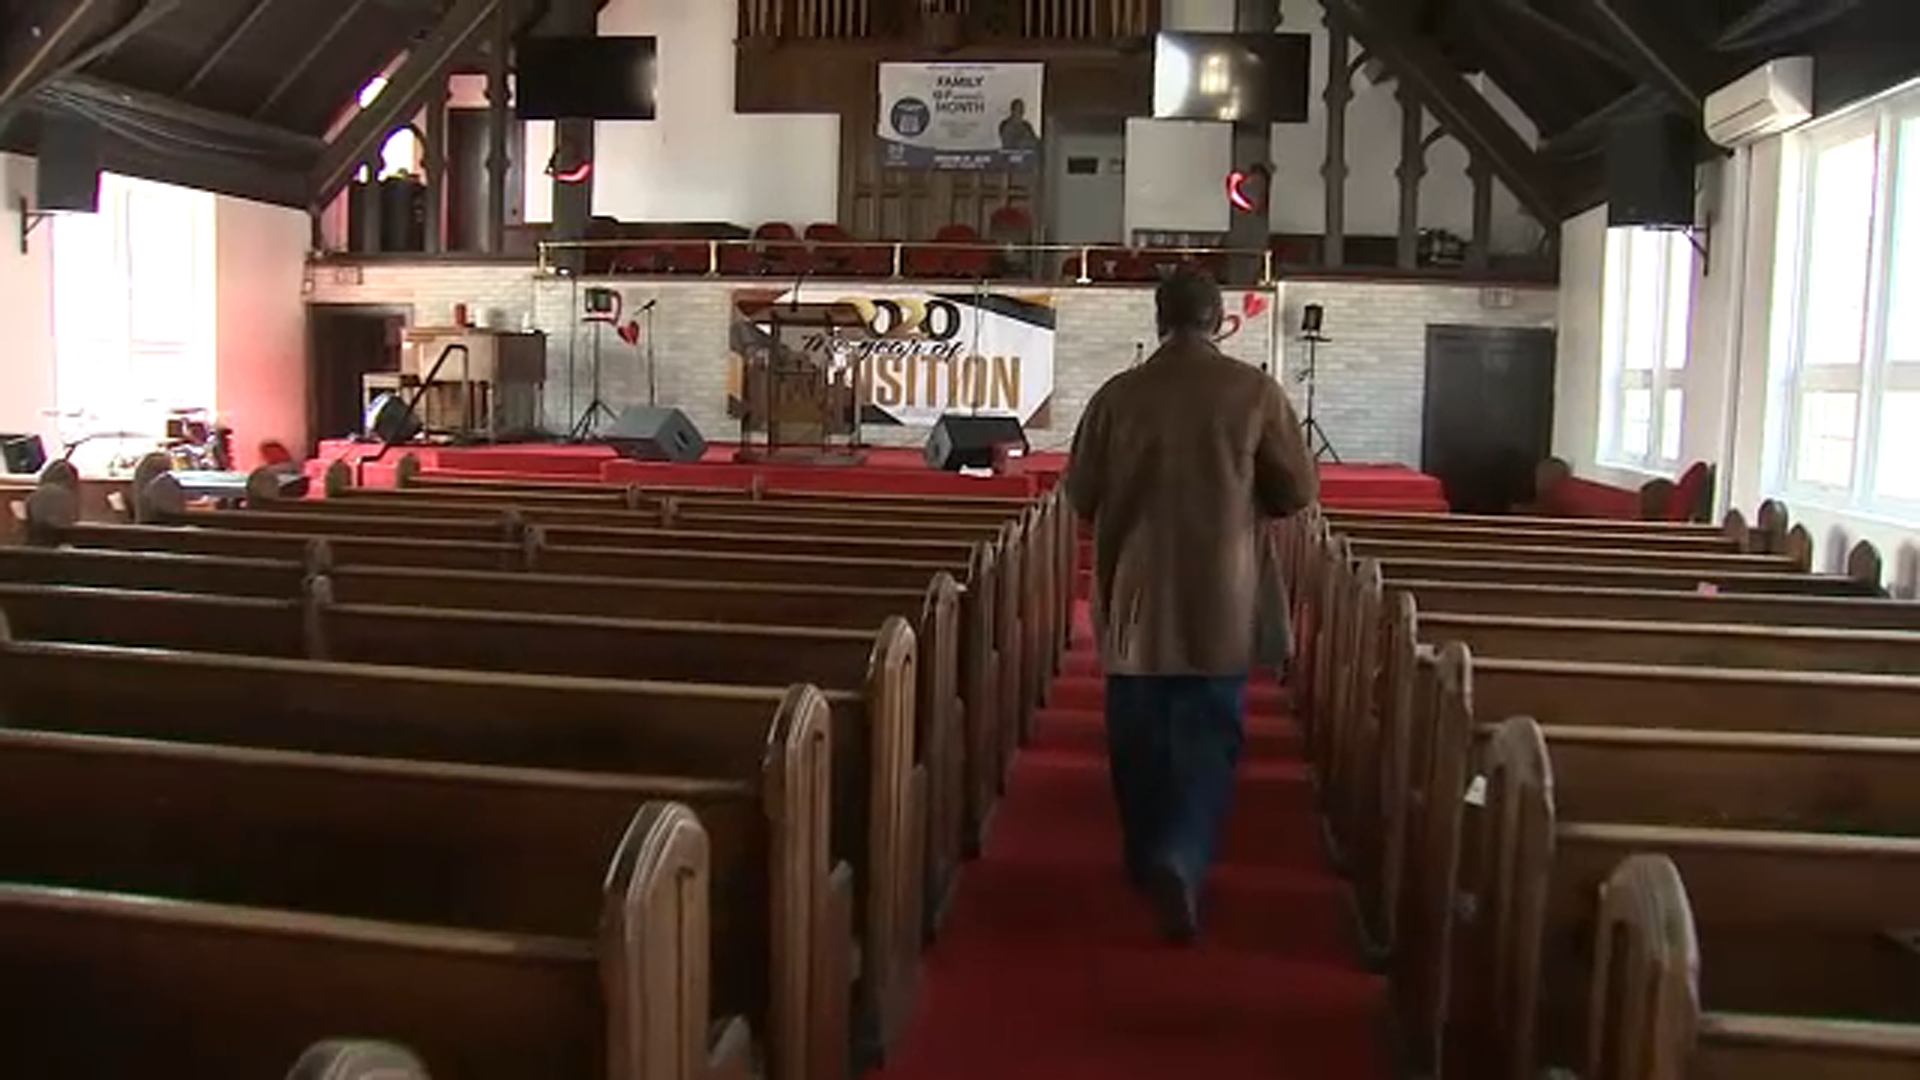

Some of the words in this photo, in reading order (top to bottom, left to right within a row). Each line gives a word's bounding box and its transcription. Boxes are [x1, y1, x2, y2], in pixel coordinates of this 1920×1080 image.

[936, 75, 985, 88] FAMILY
[935, 101, 985, 114] MONTH
[818, 354, 1021, 409] NSITION
